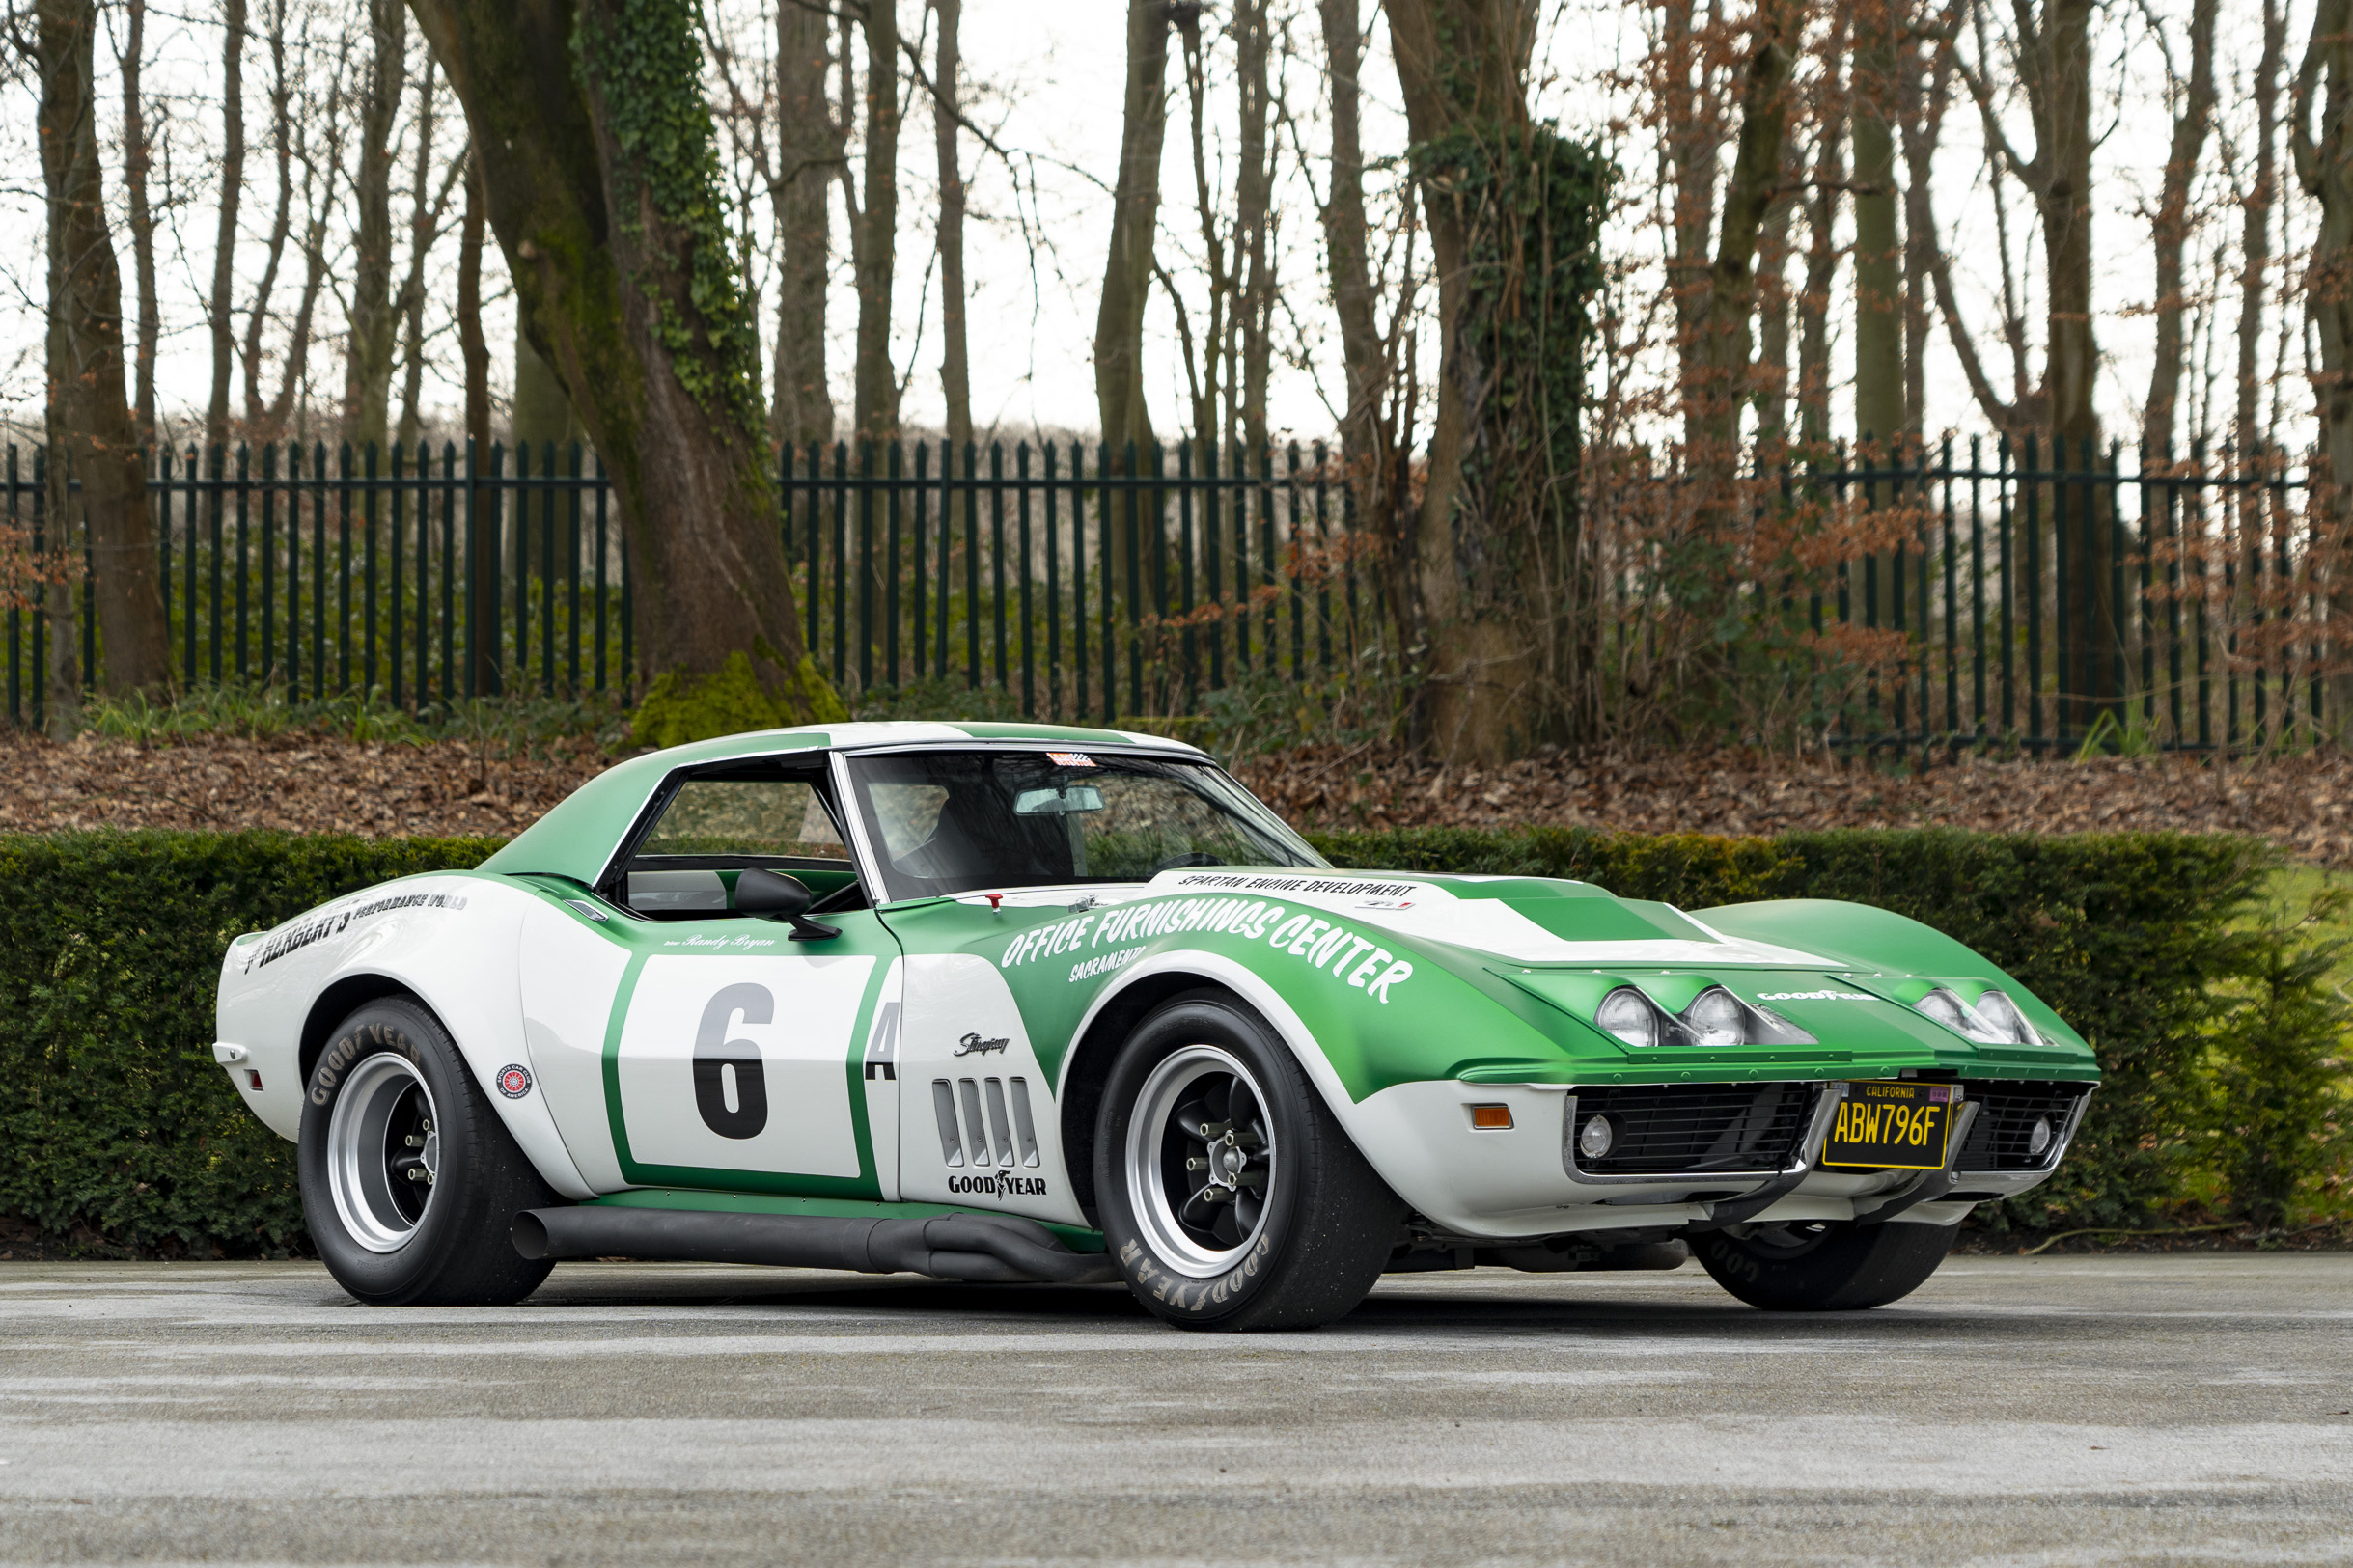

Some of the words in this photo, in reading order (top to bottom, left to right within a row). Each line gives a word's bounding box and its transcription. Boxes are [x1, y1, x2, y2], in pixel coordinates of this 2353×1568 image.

[1178, 875, 1246, 888] SPARTAN
[1245, 877, 1304, 891] ENGINE
[1303, 880, 1417, 897] DEVELOPMENT
[353, 894, 428, 920] PERFORMANCE
[428, 894, 467, 910] WORLD
[682, 934, 730, 950] Randy
[730, 934, 775, 950] Bryan
[1001, 914, 1095, 968] OFFICE
[1090, 897, 1286, 949] FURNISHINGS
[1268, 914, 1414, 1004] CENTER
[1068, 946, 1147, 983] SACRAMENTO
[865, 1002, 900, 1081] A
[953, 1032, 1010, 1057] Stingray
[311, 1023, 421, 1106] GOODYEAR
[693, 982, 775, 1140] 6
[1866, 1086, 1916, 1099] CALIFORNIA
[1834, 1101, 1940, 1146] ABW796F
[948, 1172, 1047, 1197] GOODYEAR
[1120, 1233, 1270, 1311] GOODYEAR
